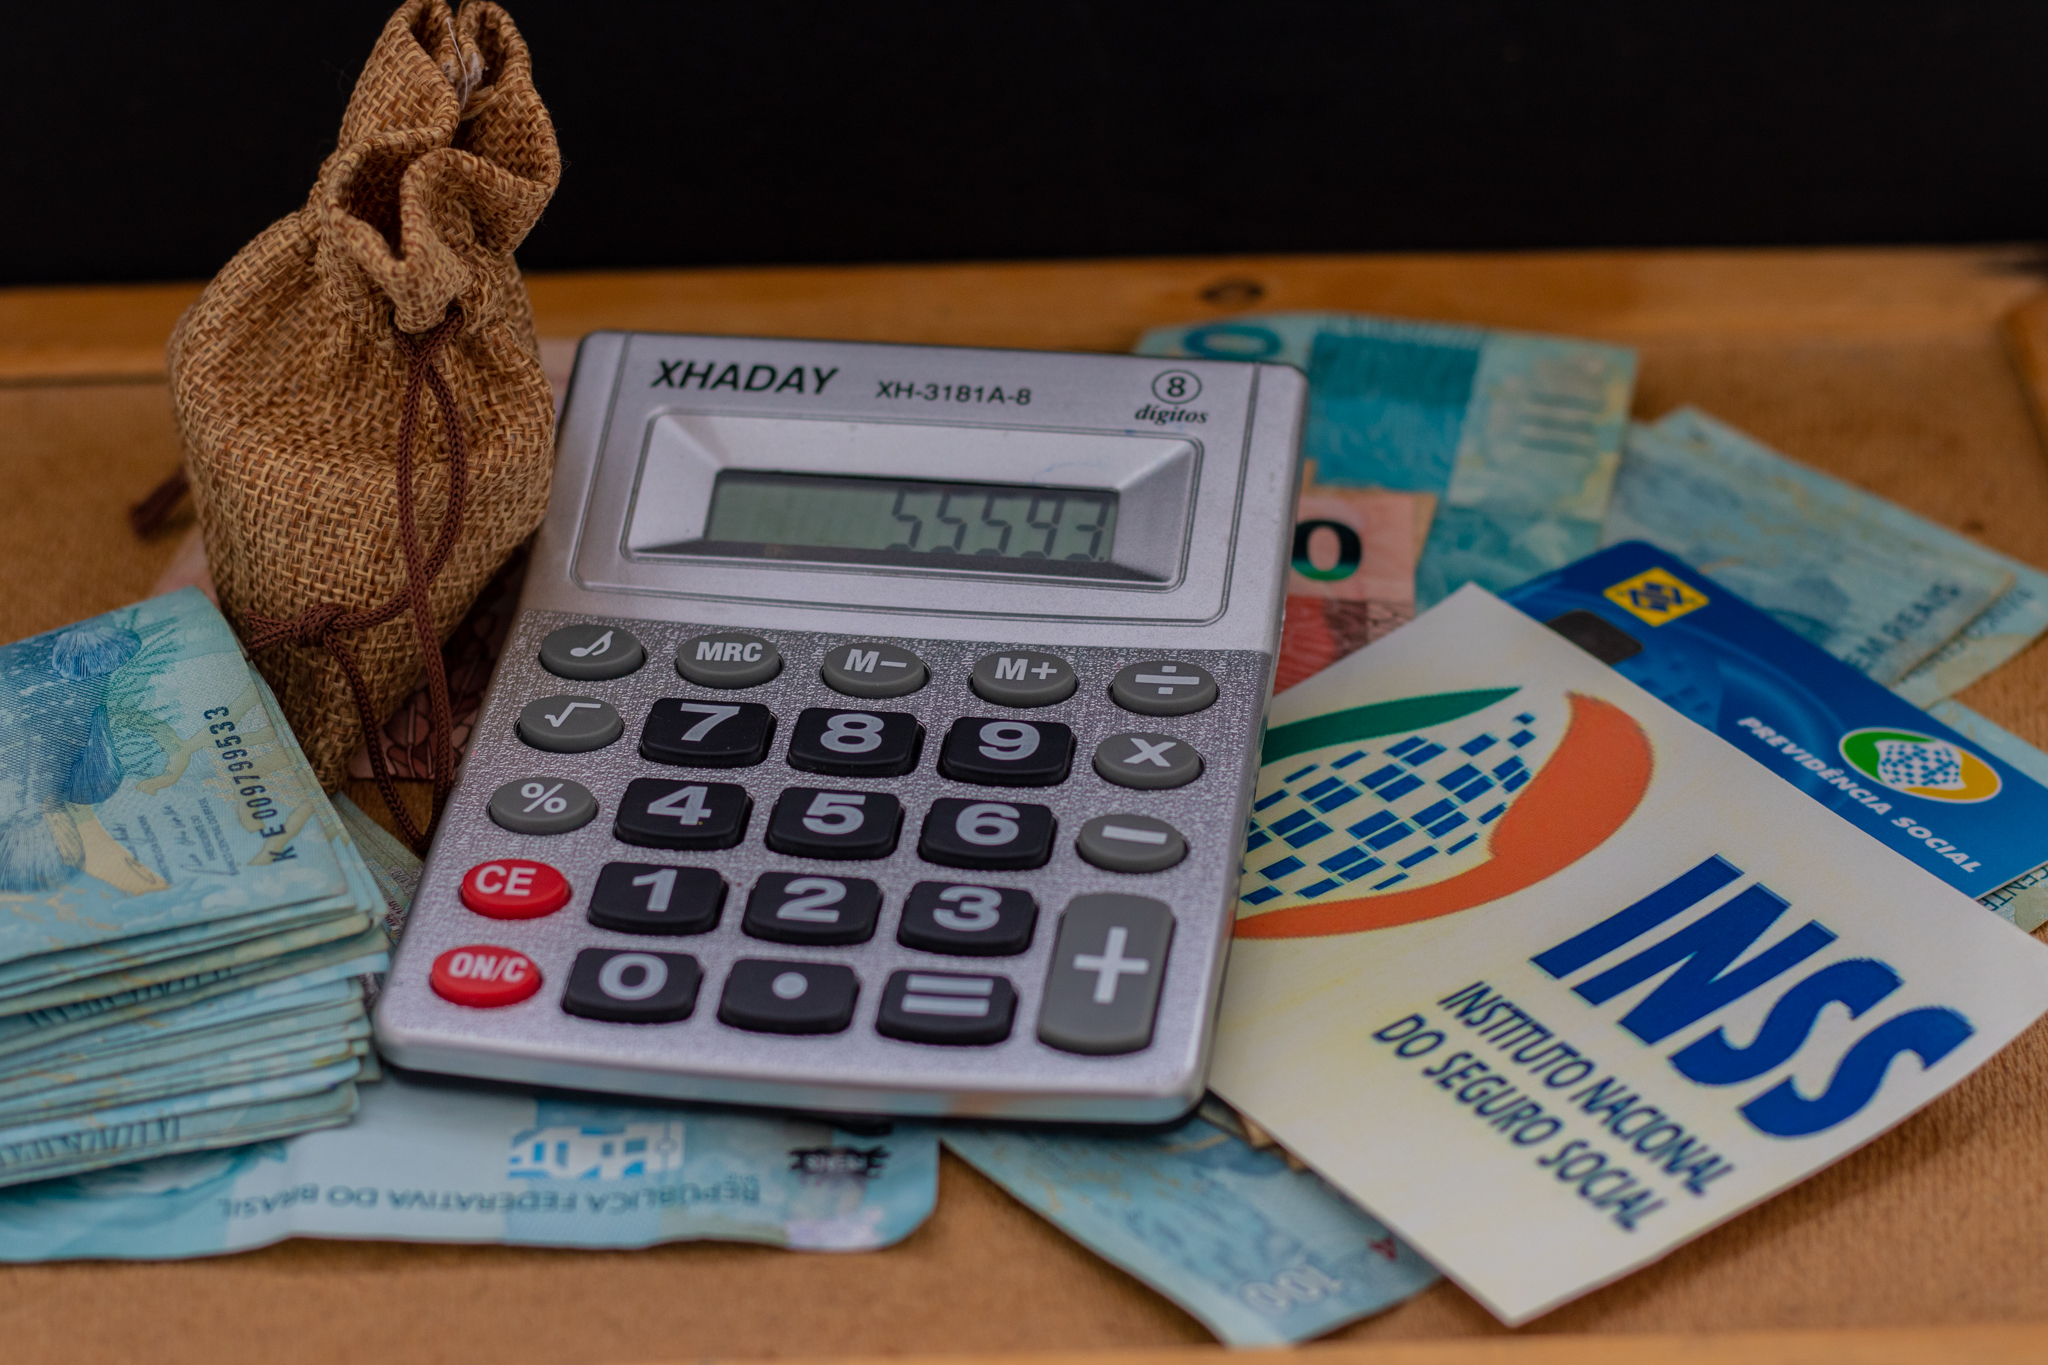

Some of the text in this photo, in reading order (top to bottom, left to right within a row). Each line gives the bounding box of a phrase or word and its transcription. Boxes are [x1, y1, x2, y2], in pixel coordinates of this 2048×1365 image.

[650, 359, 1032, 406] XHADAY XH-3181A-8
[1166, 376, 1187, 398] 8
[1134, 404, 1209, 426] dígitos
[696, 641, 763, 663] MRC
[994, 656, 1058, 681] M+
[680, 703, 740, 742] 7
[820, 713, 884, 754] 8
[978, 721, 1041, 761] 9
[203, 704, 278, 820] 009799533
[647, 785, 712, 827] 4
[802, 793, 866, 835] 5
[1737, 716, 1982, 873] PREVIDÊNCIA SOCIAL
[955, 803, 1021, 846] 6
[475, 864, 537, 897] CE
[632, 868, 679, 912] 1
[777, 877, 848, 923] 2
[933, 885, 1003, 932] 3
[447, 951, 529, 982] ON/C
[598, 952, 669, 1000] 0
[1528, 854, 1977, 1140] INSS
[1438, 980, 1736, 1197] INSTITUTO NACIONAL
[1371, 1013, 1668, 1233] DO SEGURO SOCIAL
[220, 1182, 321, 1219] BRASIL
[326, 1185, 379, 1210] DO
[386, 1187, 579, 1214] FEDERATIVA
